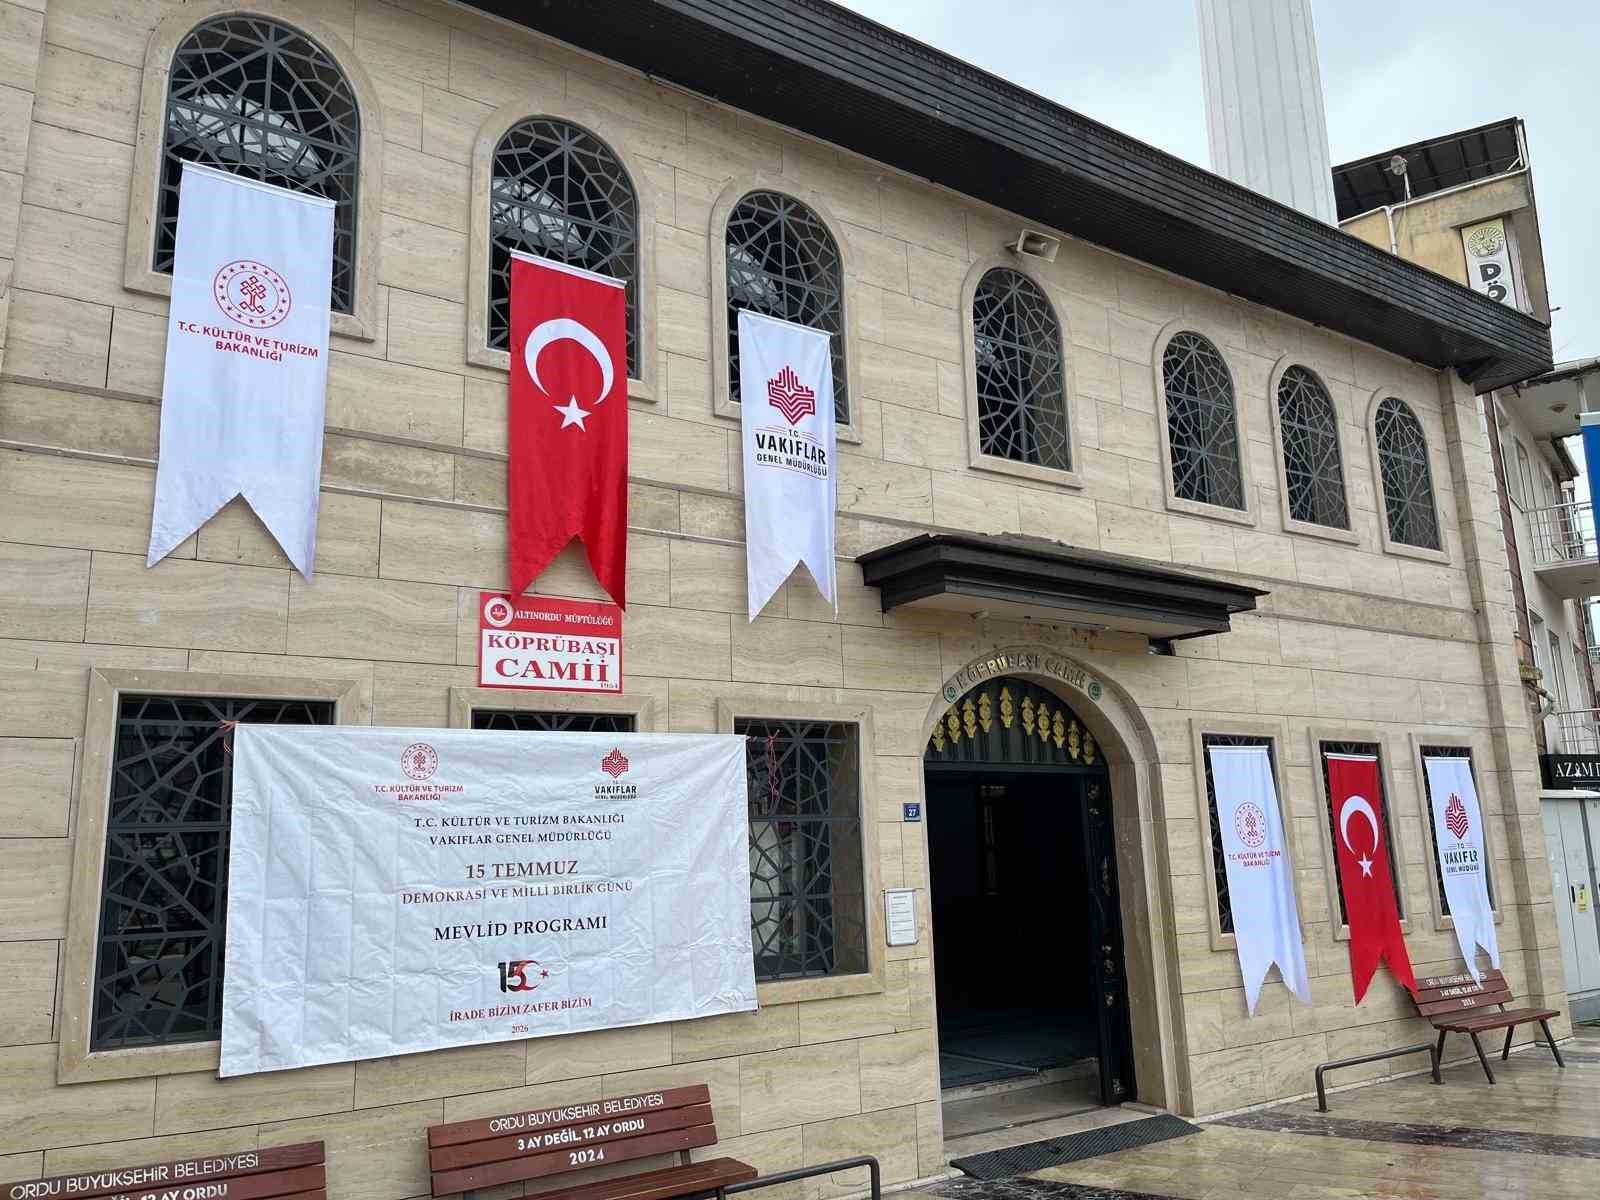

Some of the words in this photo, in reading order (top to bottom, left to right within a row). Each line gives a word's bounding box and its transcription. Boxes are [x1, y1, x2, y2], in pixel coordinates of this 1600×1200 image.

[178, 321, 200, 335] T.C.
[202, 325, 251, 344] KÜLTÜR
[254, 336, 271, 348] VE
[273, 340, 319, 358] TURİZM
[215, 340, 283, 362] BAKANLIĞI
[756, 433, 826, 465] VAKIFLAR
[757, 453, 783, 464] GENEL
[786, 458, 828, 477] MÜDÜRLÜĞÜ
[514, 610, 562, 622] ALTINORDU
[564, 613, 613, 626] MÜFTÜLÜĞÜ
[488, 632, 616, 658] KÖPRÜBAŞI
[495, 658, 609, 682] CAMİİ
[374, 785, 388, 793] T.C.
[389, 784, 420, 793] KÜLTÜR
[434, 785, 464, 793] TURİZM
[398, 793, 441, 801] BAKANLIĞI
[594, 785, 637, 794] VAKIFLAR
[414, 818, 438, 828] T.C.
[441, 816, 491, 827] KÜLTÜR
[495, 816, 511, 826] VE
[513, 814, 560, 825] TURİZM
[562, 813, 624, 825] BAKANLIĞI
[429, 835, 492, 845] VAKIFLAR
[496, 833, 534, 844] GENEL
[538, 830, 612, 842] MÜDÜRLÜĞÜ
[466, 863, 485, 879] 15
[491, 860, 578, 878] TEMMUZ
[489, 888, 508, 899] VE
[597, 880, 633, 893] GÜNÜ
[435, 921, 507, 941] MEVLİD
[514, 916, 607, 935] PROGRAMI
[450, 1008, 486, 1022] İRADE
[488, 1004, 521, 1018] BİZİM
[522, 1001, 559, 1015] ZAFER
[561, 997, 593, 1010] BİZİM
[512, 1024, 529, 1034] 2026
[490, 1117, 525, 1133] ORDU
[604, 1094, 664, 1114] BELEDİYESİ
[518, 1139, 525, 1151] 3
[527, 1136, 542, 1149] AY
[545, 1127, 582, 1145] DEĞİL,
[584, 1127, 595, 1139] 12
[597, 1125, 610, 1138] AY
[613, 1118, 645, 1134] ORDU
[570, 1148, 604, 1166] 2024
[10, 1180, 61, 1200] ORDU
[174, 1153, 259, 1178] BELEDİYESİ
[183, 1183, 228, 1200] ORDU
